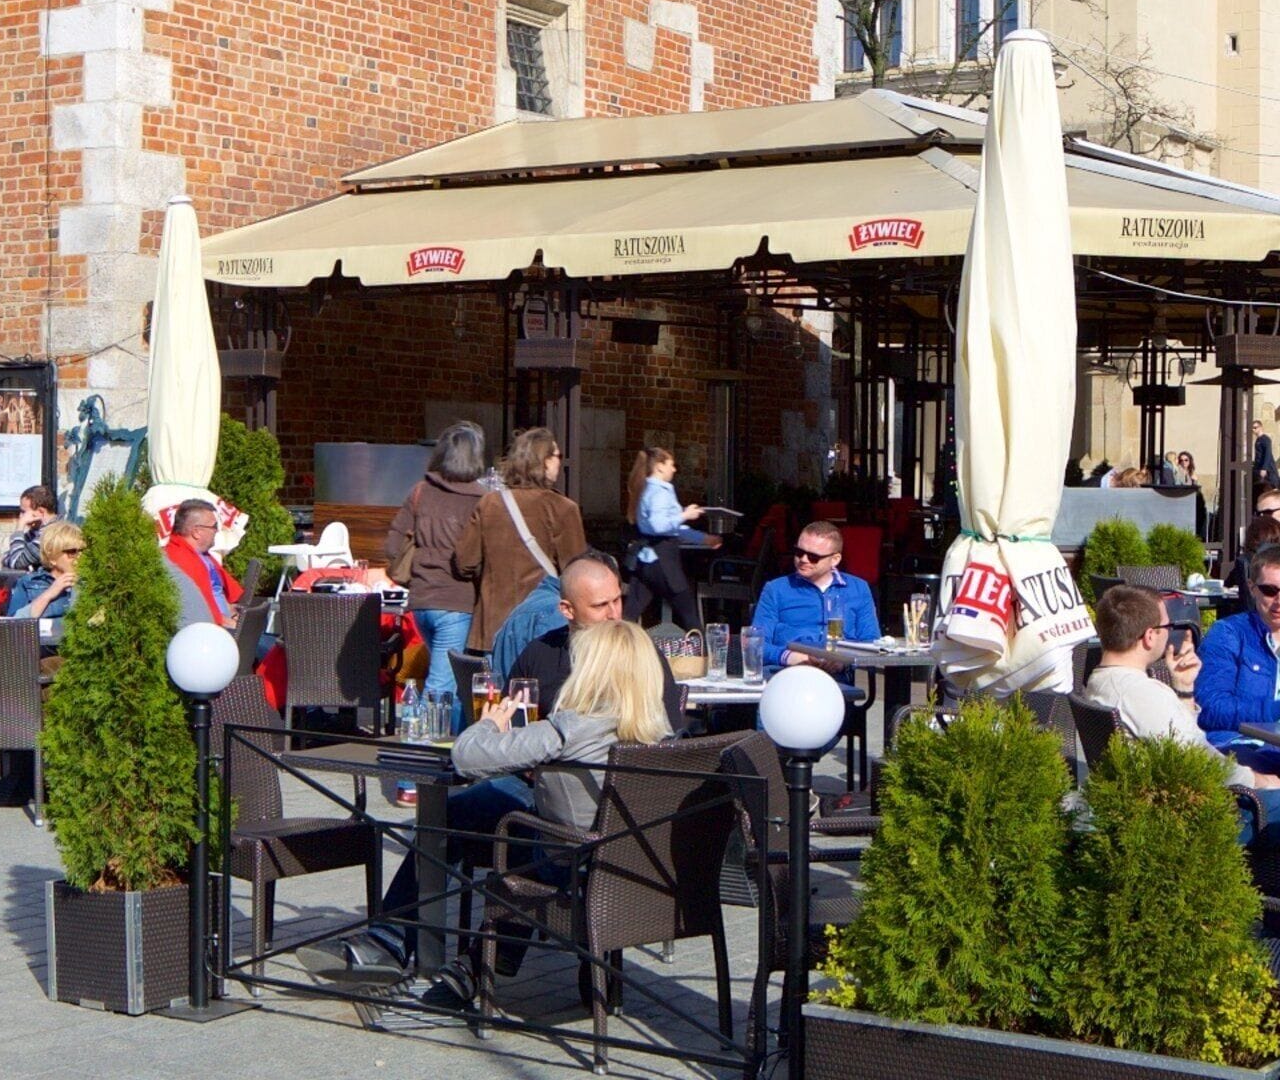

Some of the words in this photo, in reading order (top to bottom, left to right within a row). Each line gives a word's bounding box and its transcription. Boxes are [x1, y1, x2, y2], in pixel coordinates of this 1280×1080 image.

[858, 220, 917, 242] ŻYWIEC
[1121, 216, 1205, 239] RATUSZOWA
[614, 235, 685, 256] RATUSZOWA
[1132, 240, 1189, 250] restauracja
[216, 257, 273, 276] RATUSZOWA
[414, 249, 460, 269] ŻYWIEC
